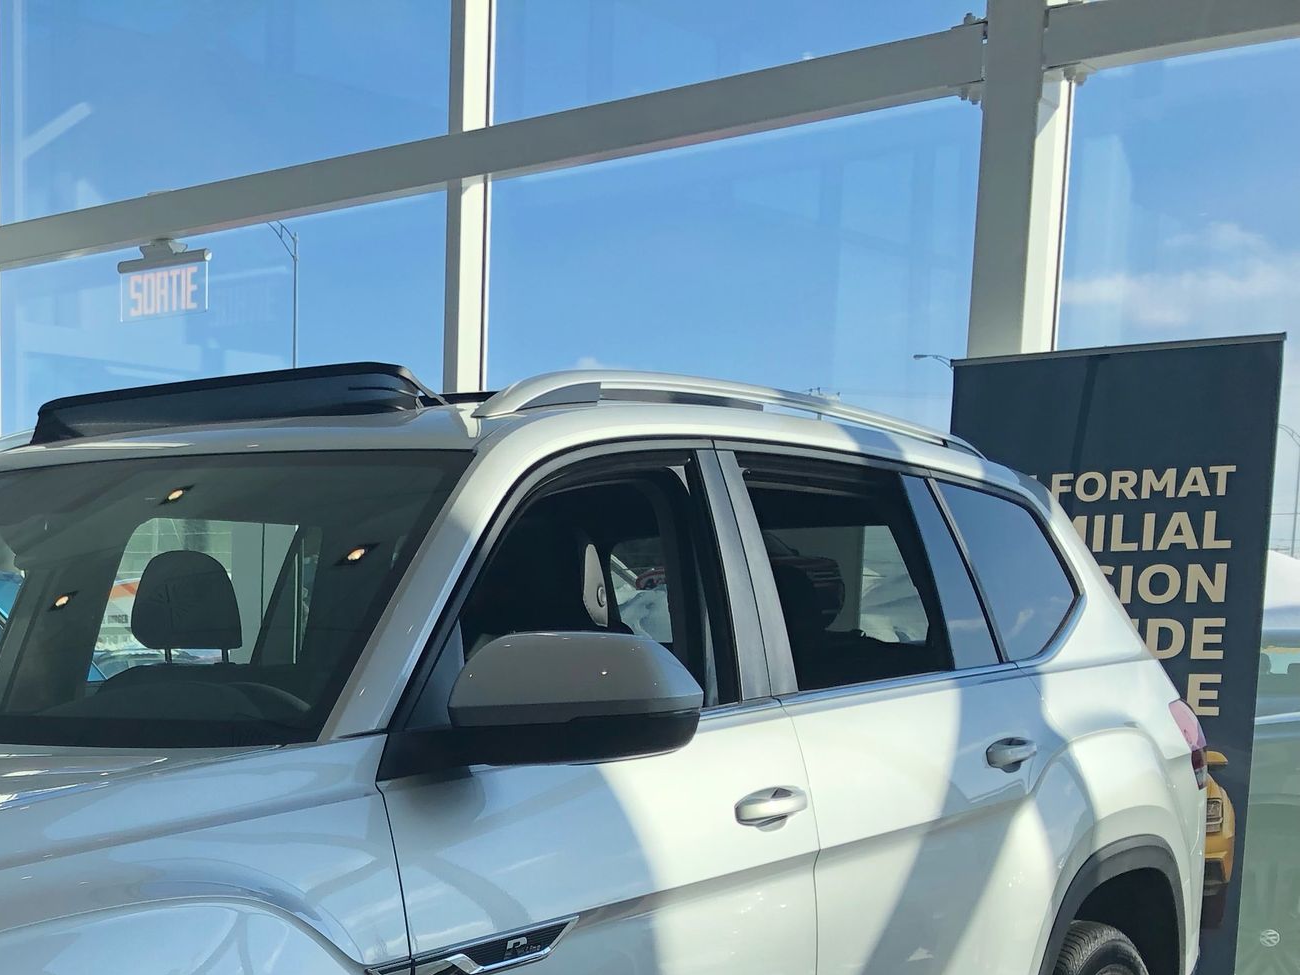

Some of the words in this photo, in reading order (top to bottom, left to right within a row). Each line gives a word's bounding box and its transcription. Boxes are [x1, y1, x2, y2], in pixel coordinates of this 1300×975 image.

[129, 266, 198, 317] SORTIE
[1050, 465, 1237, 503] FORMAT
[1132, 617, 1226, 660] DE
